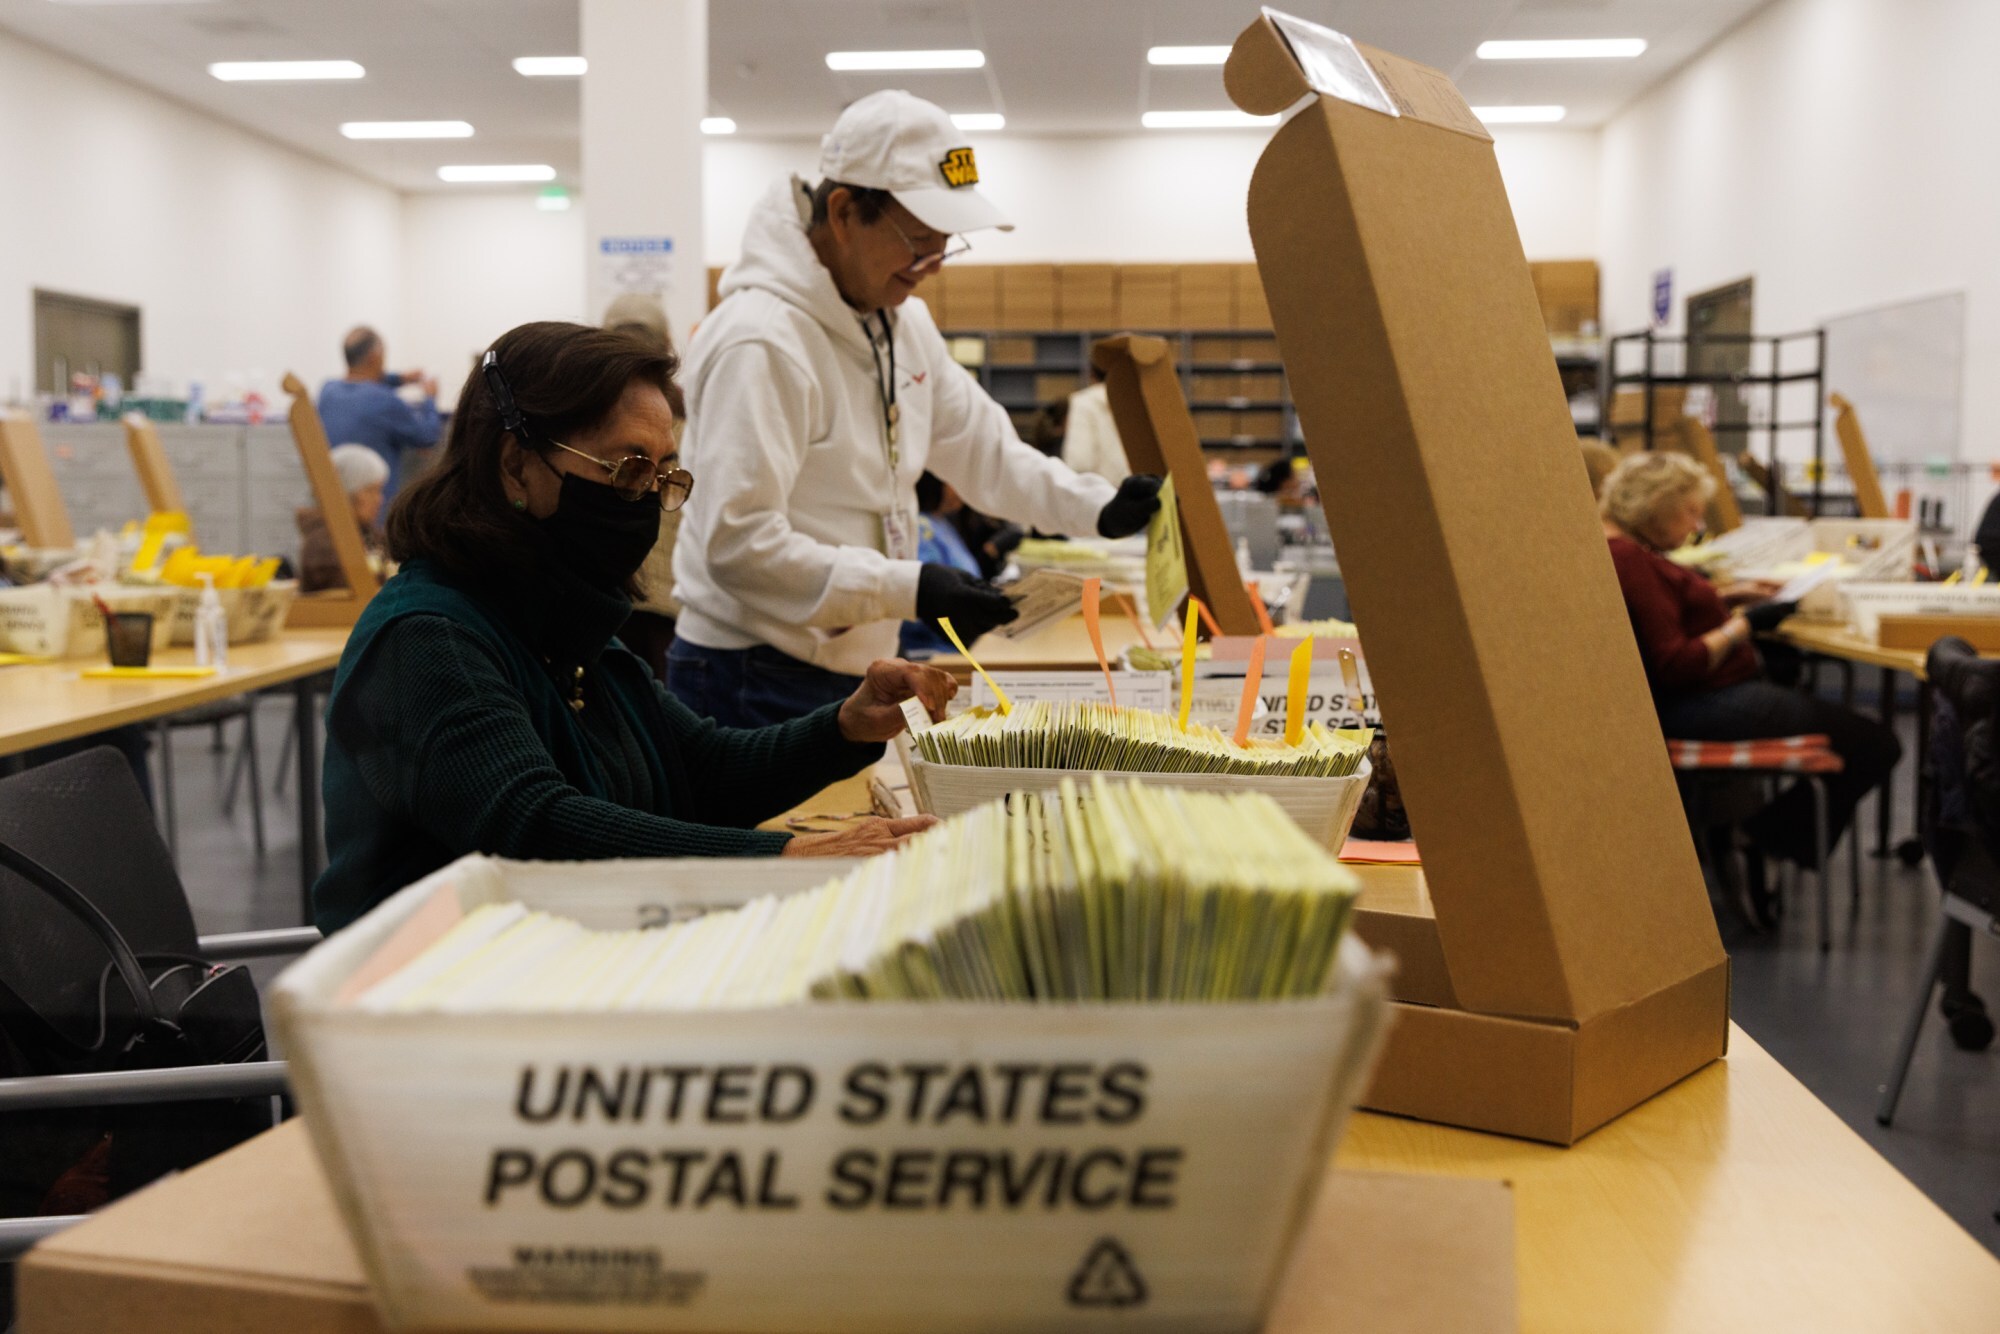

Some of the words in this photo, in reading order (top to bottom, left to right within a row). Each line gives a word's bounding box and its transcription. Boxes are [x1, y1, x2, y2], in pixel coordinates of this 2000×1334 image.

[514, 1064, 817, 1125] UNITED
[836, 1062, 1151, 1126] STATES
[485, 1149, 801, 1211] POSTAL
[823, 1147, 1187, 1213] SERVICE
[513, 1246, 661, 1265] WARNING
